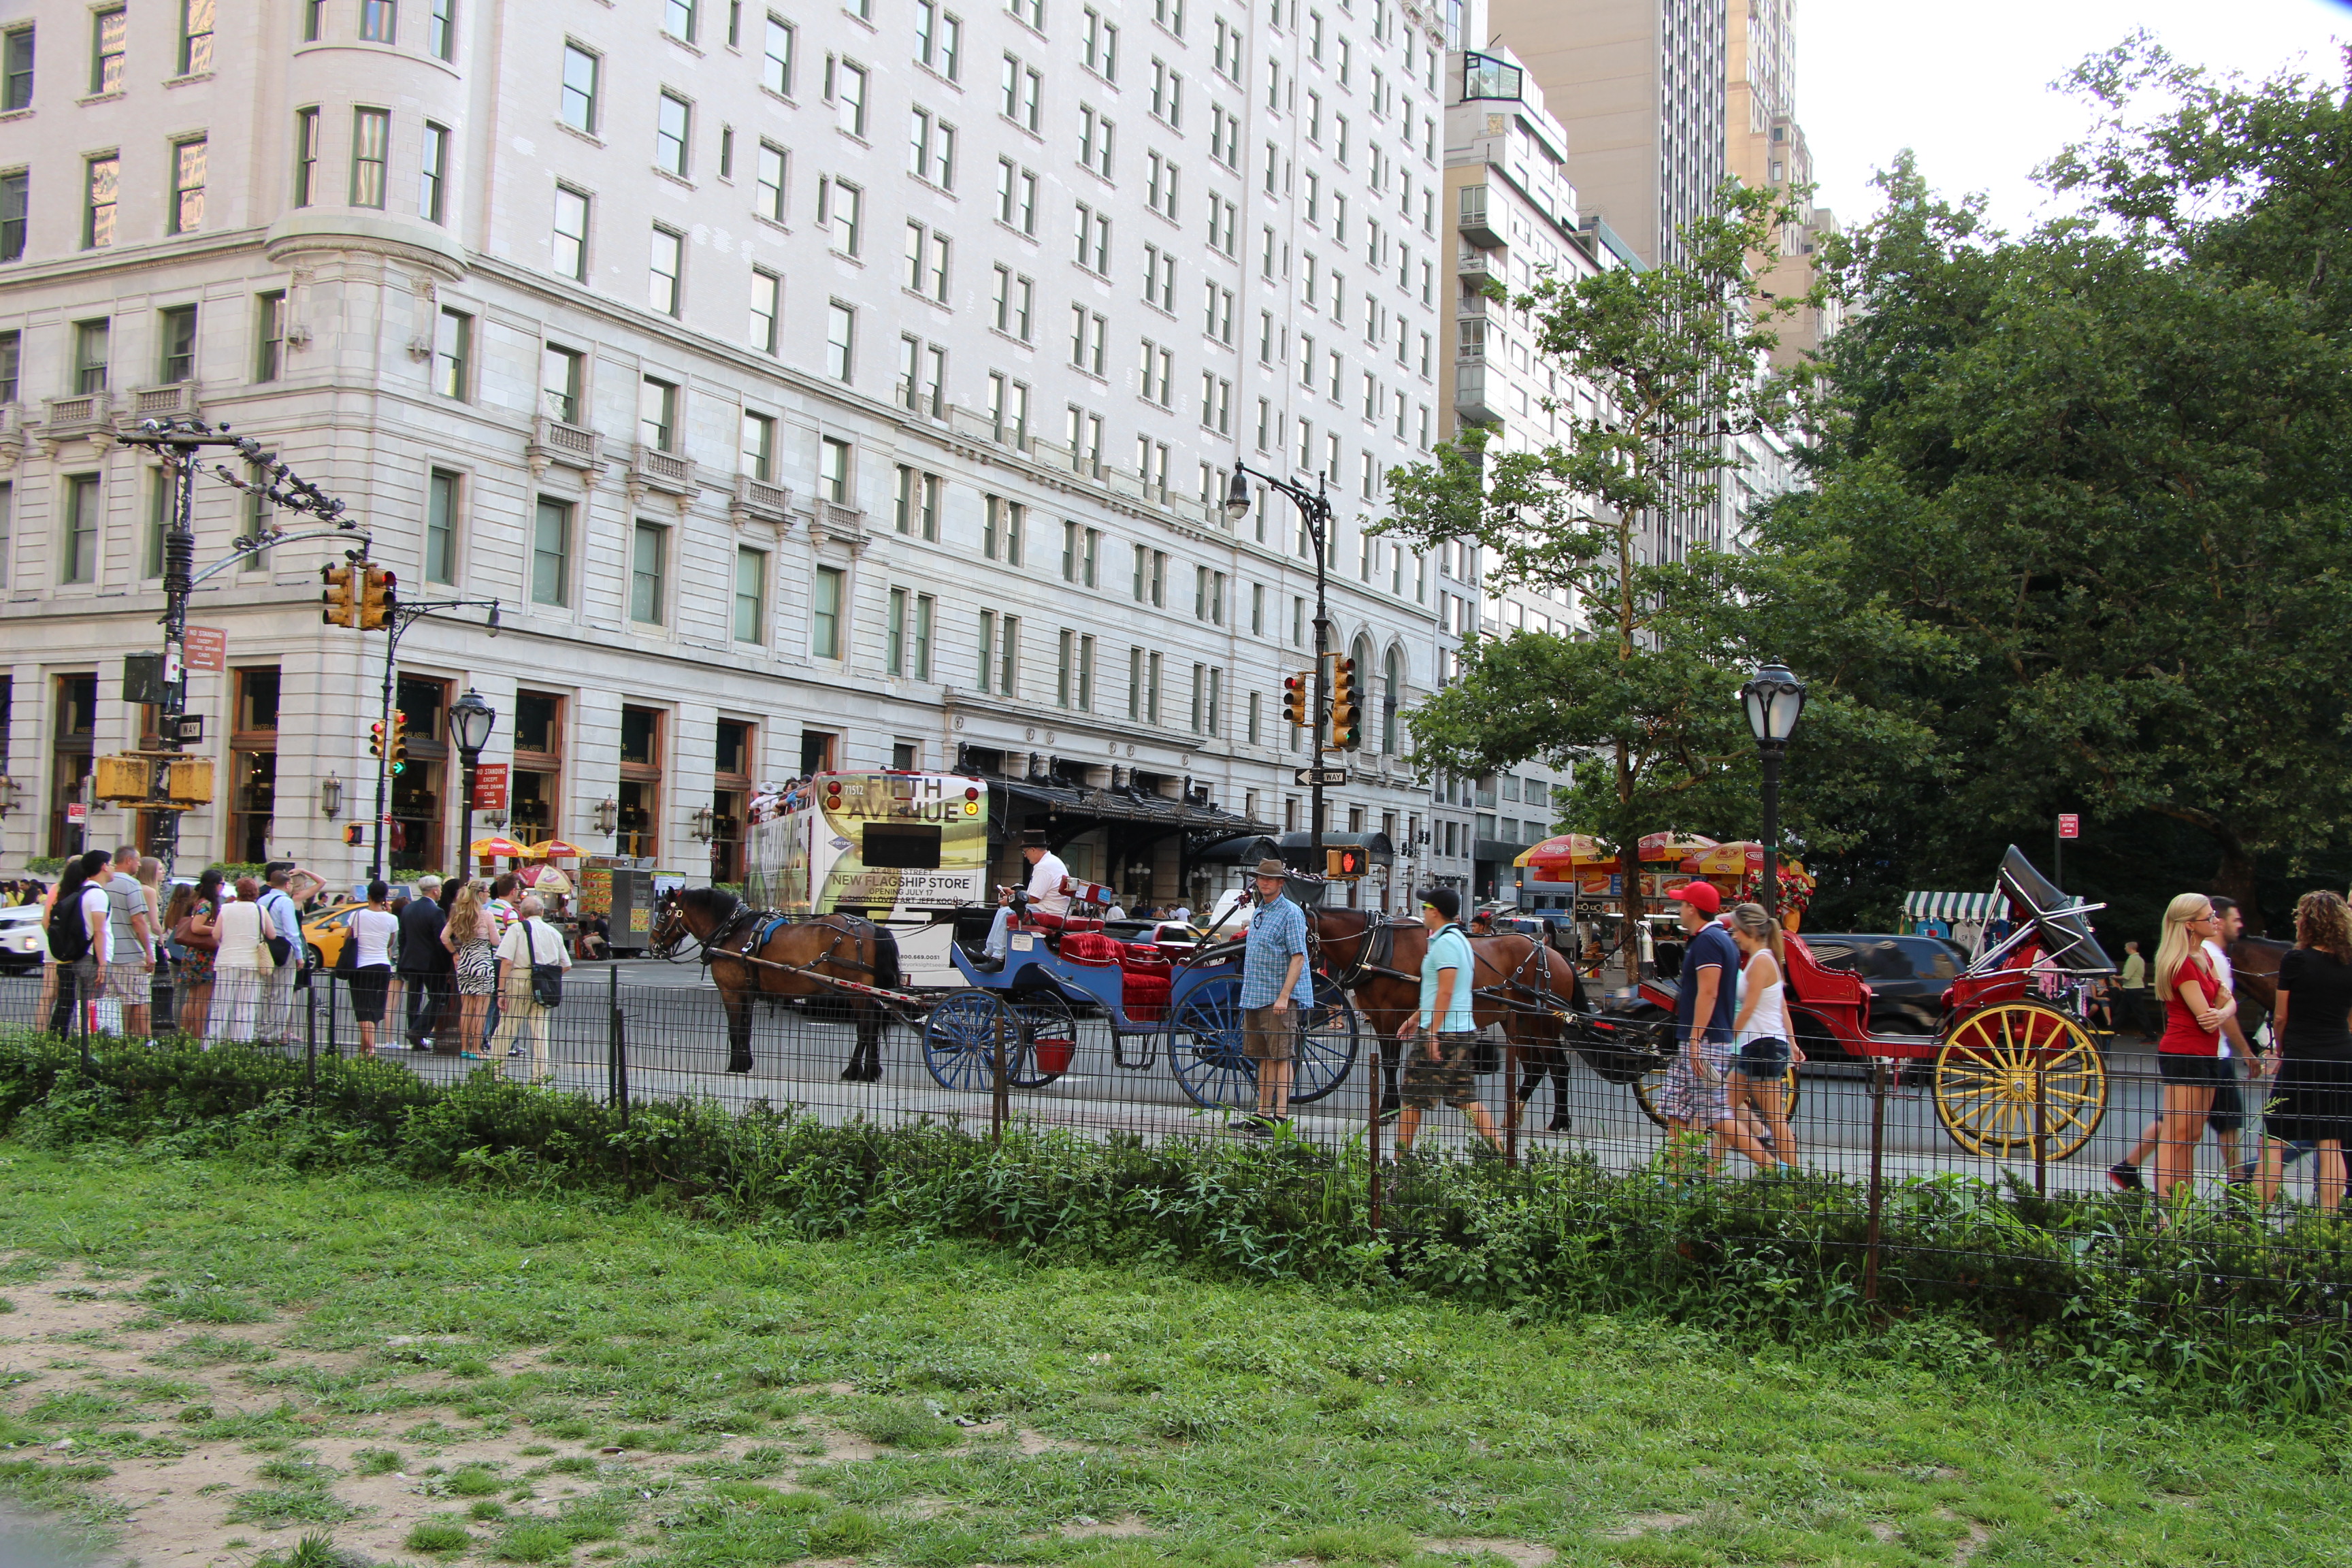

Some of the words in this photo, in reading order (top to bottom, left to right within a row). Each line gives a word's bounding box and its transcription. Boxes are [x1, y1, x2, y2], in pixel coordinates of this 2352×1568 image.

[199, 630, 223, 638] STANDING
[183, 723, 197, 735] WAY
[519, 744, 543, 752] GALASSO
[845, 785, 864, 796] 71512
[867, 775, 942, 799] FIFTH
[847, 798, 959, 823] AVENUE
[832, 875, 862, 885] NEW
[865, 875, 926, 887] FLAGSHIP
[929, 877, 970, 889] STORE
